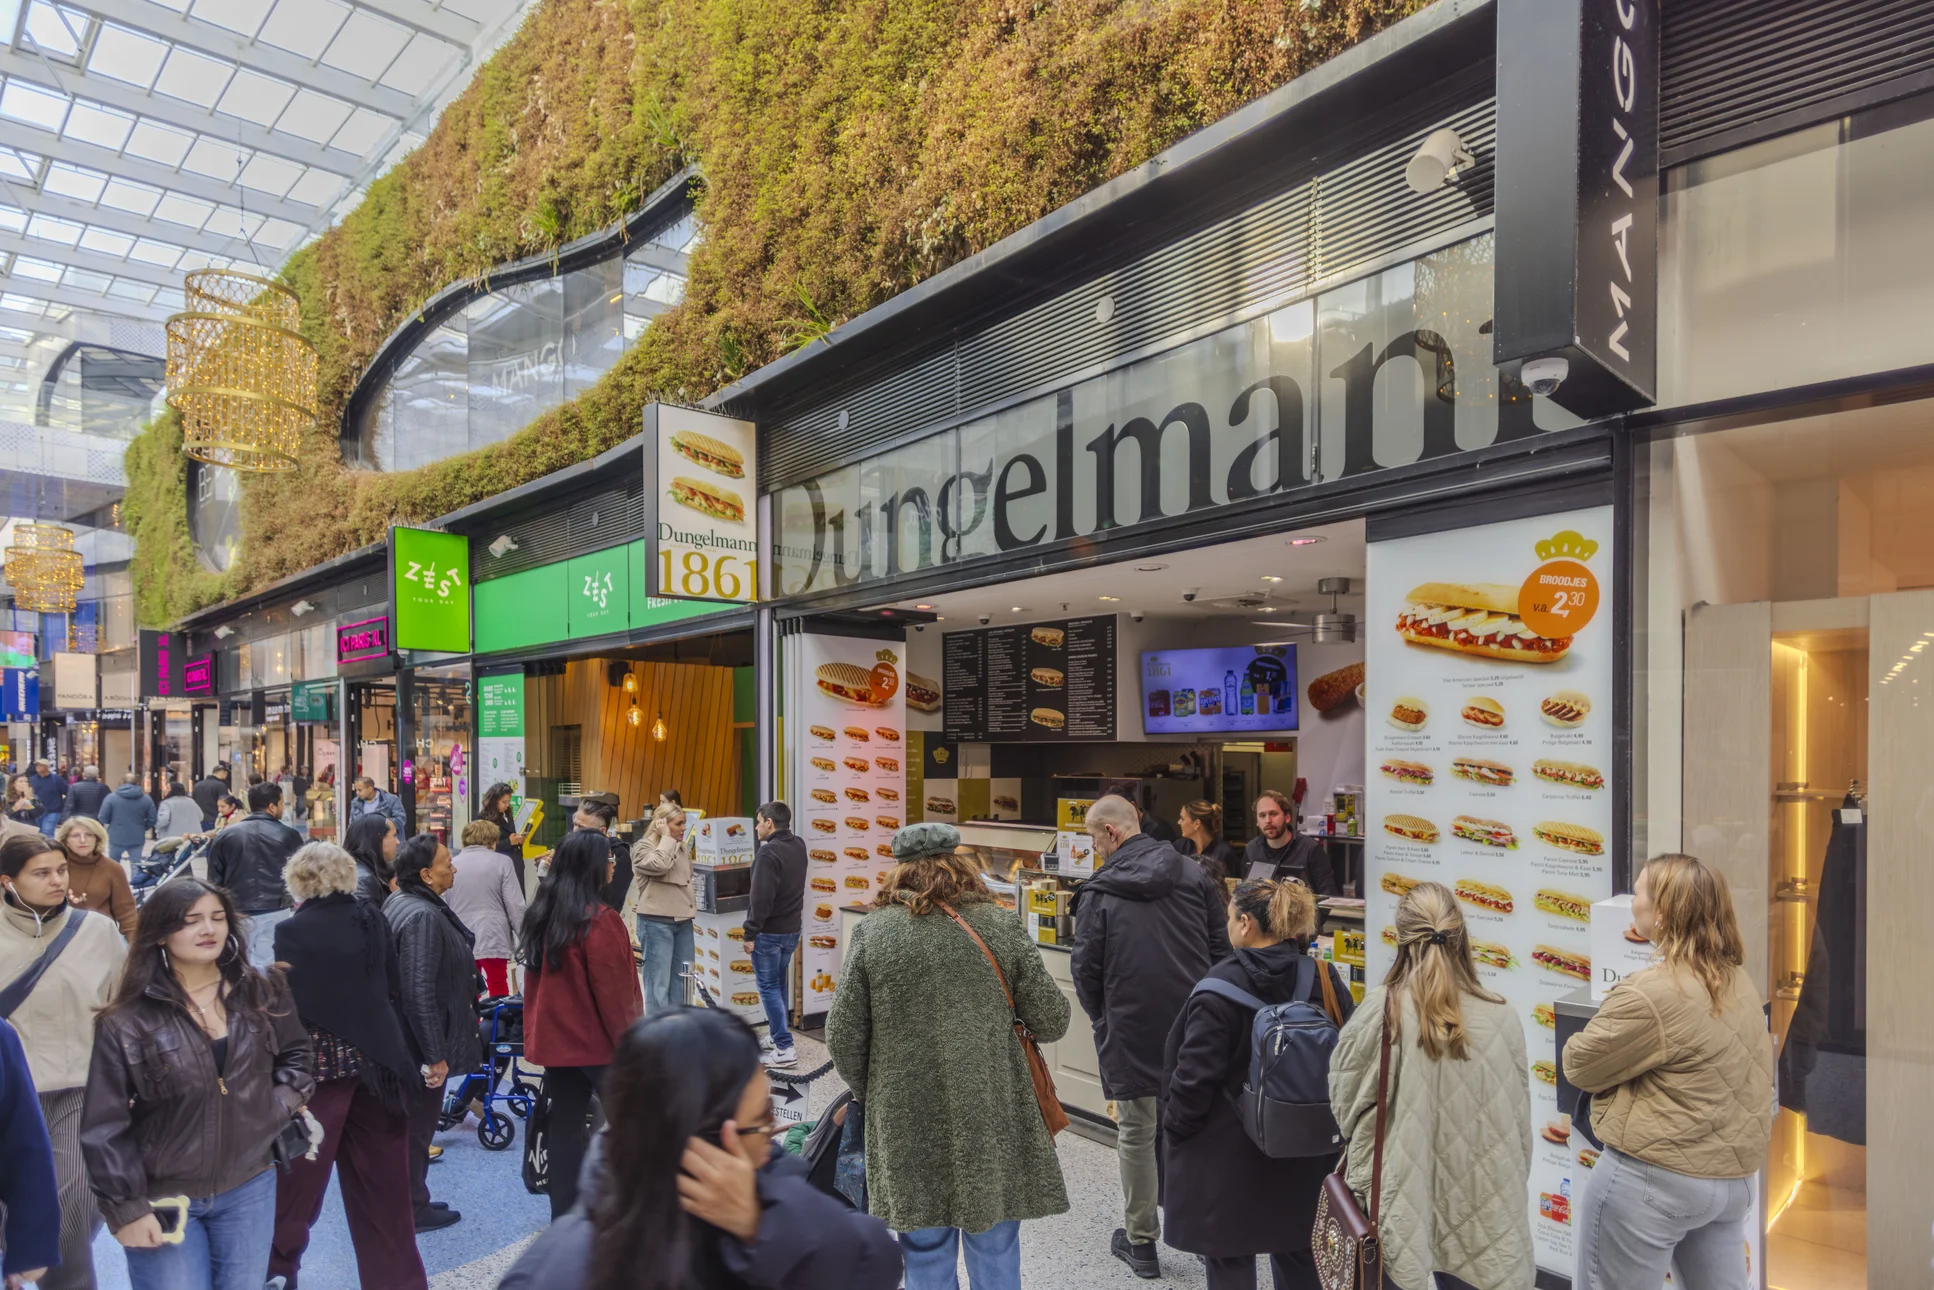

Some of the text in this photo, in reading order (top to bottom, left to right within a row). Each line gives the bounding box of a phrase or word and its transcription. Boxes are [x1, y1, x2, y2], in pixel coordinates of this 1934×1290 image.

[658, 522, 757, 551] Dungelmann
[658, 549, 757, 601] 1861
[1539, 574, 1588, 588] BROODJES
[1533, 603, 1549, 613] v.a.
[351, 631, 370, 651] PARIS
[158, 649, 169, 679] PARIS
[771, 1106, 803, 1122] ESTELLEN
